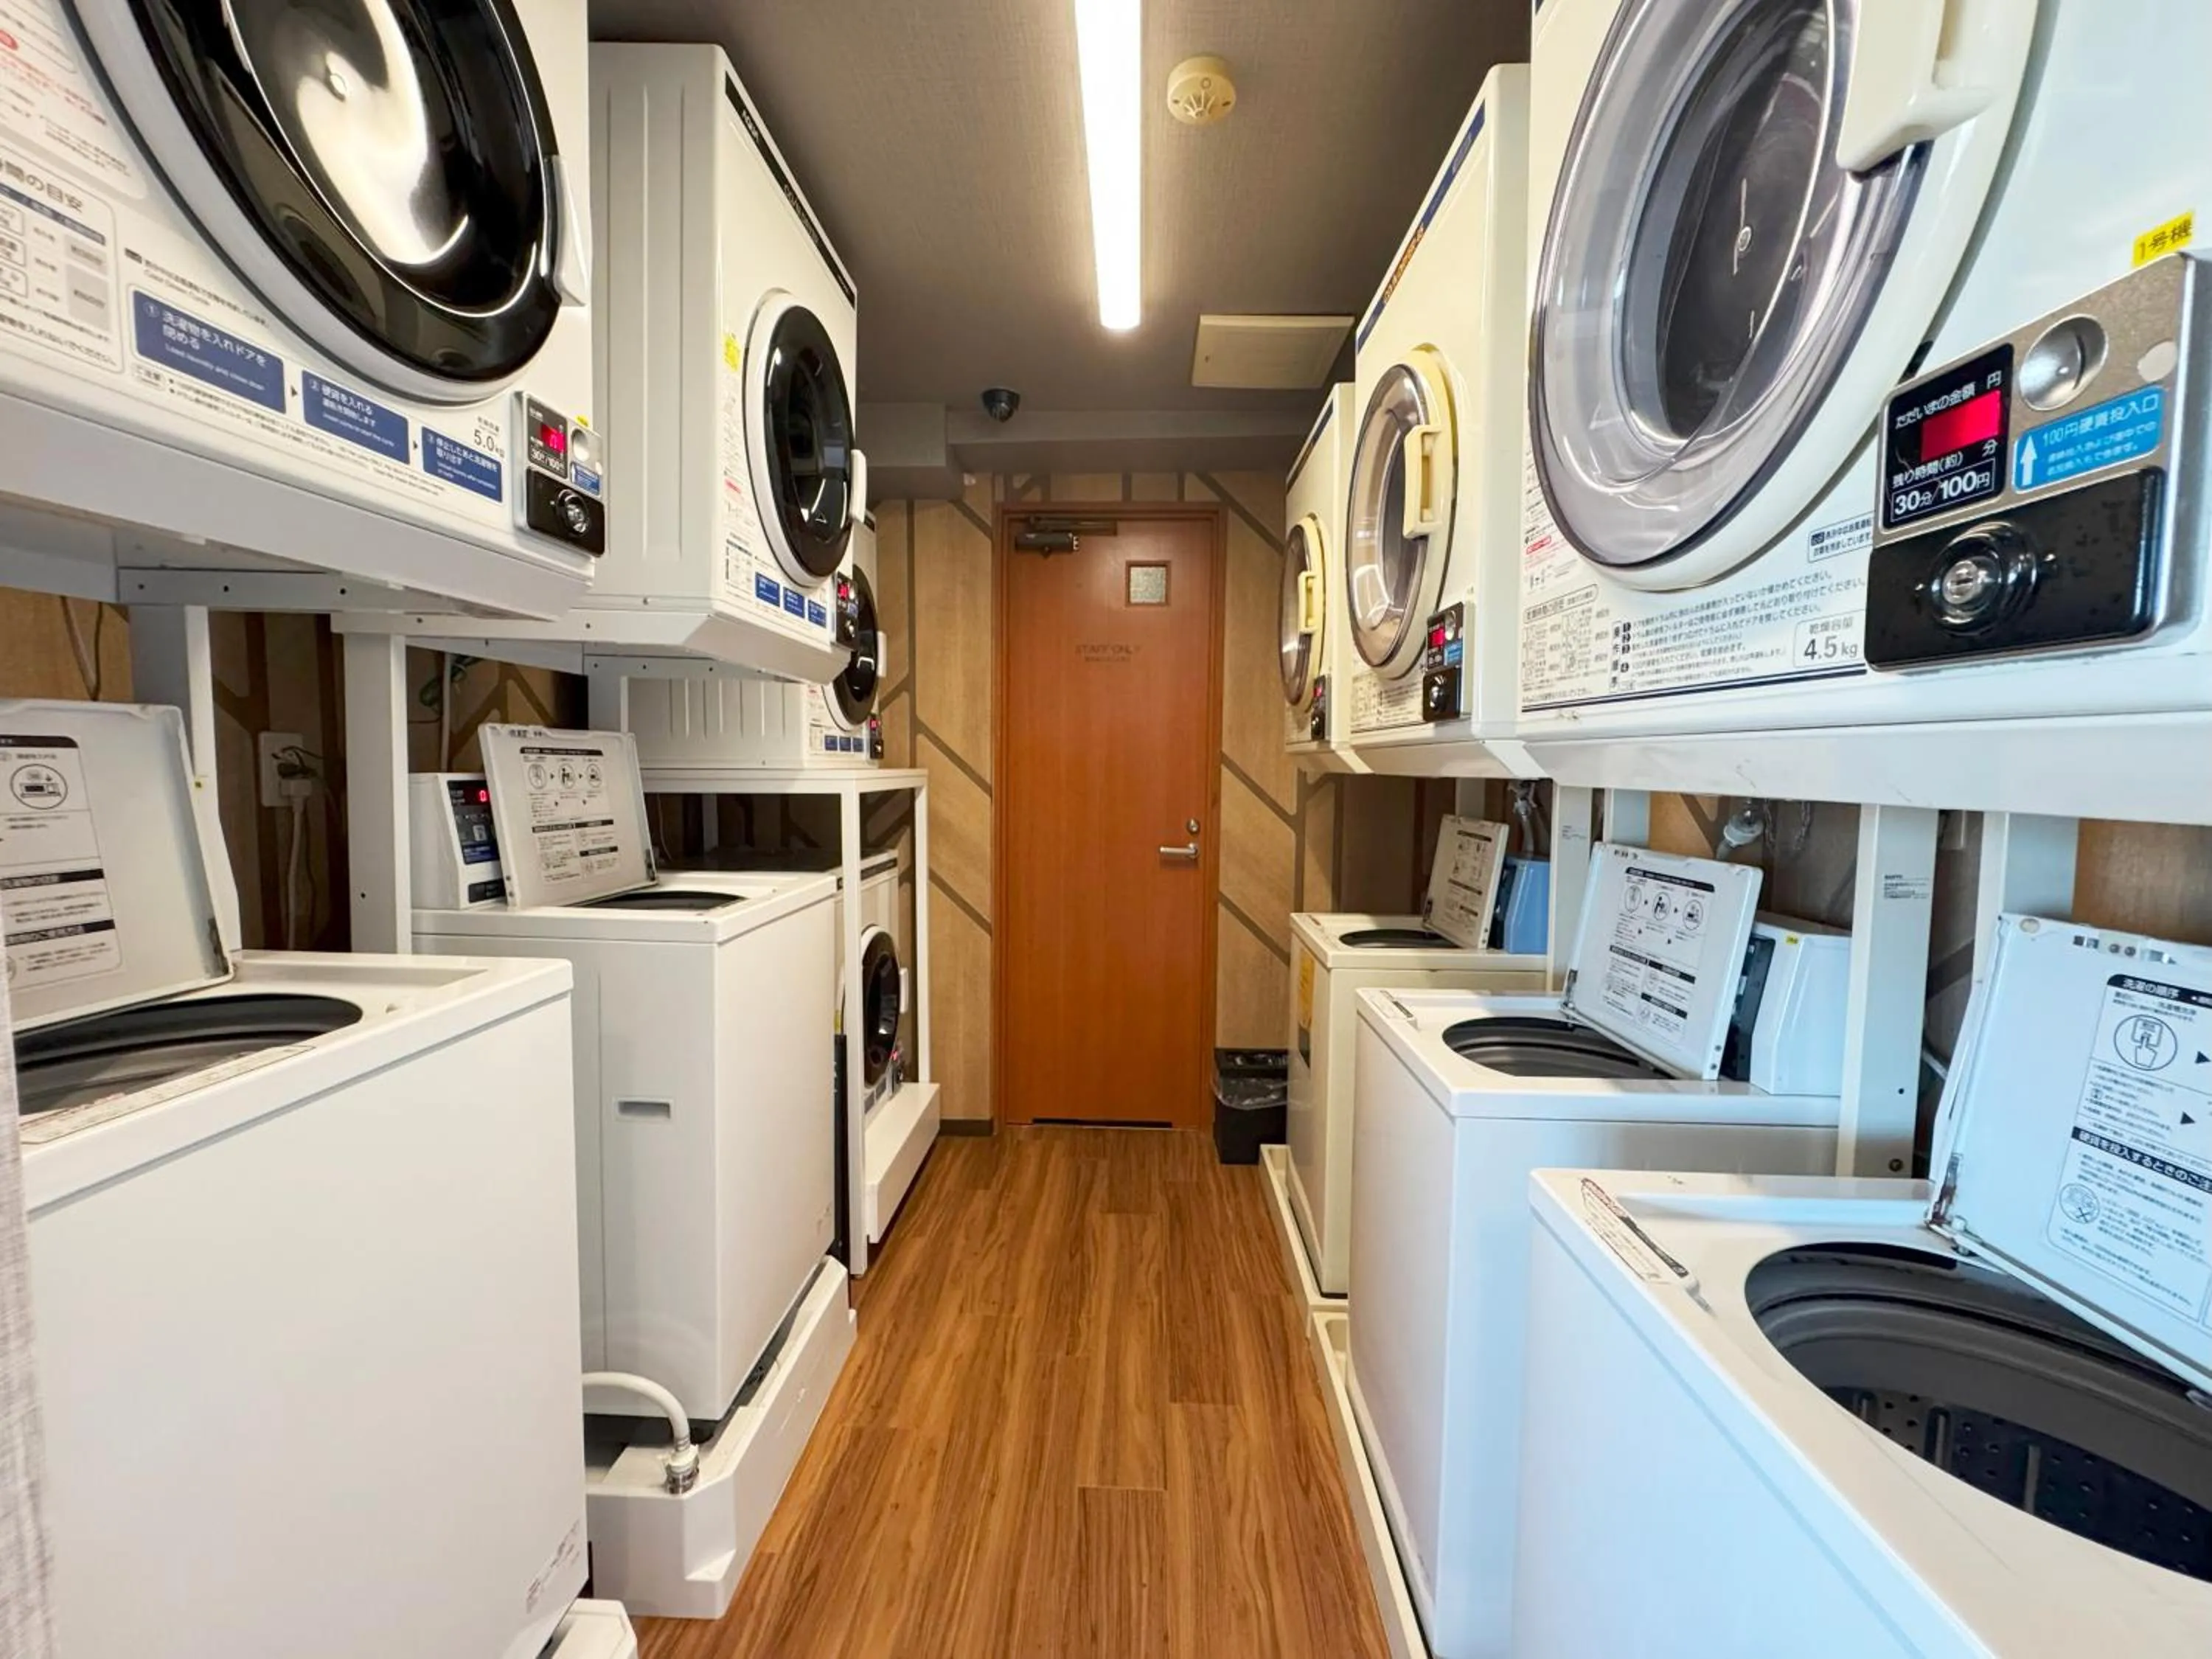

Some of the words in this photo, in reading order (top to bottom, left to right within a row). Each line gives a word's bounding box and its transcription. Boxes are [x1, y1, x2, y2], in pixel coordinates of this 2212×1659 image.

[2137, 220, 2193, 261] 1号機
[1894, 381, 1976, 430] ただいまの金額
[1986, 369, 2003, 390] 円
[2042, 393, 2160, 447] 100円硬貨投入口
[1982, 438, 1998, 457] 分
[1804, 635, 1837, 661] 4.5
[1840, 641, 1859, 659] kg
